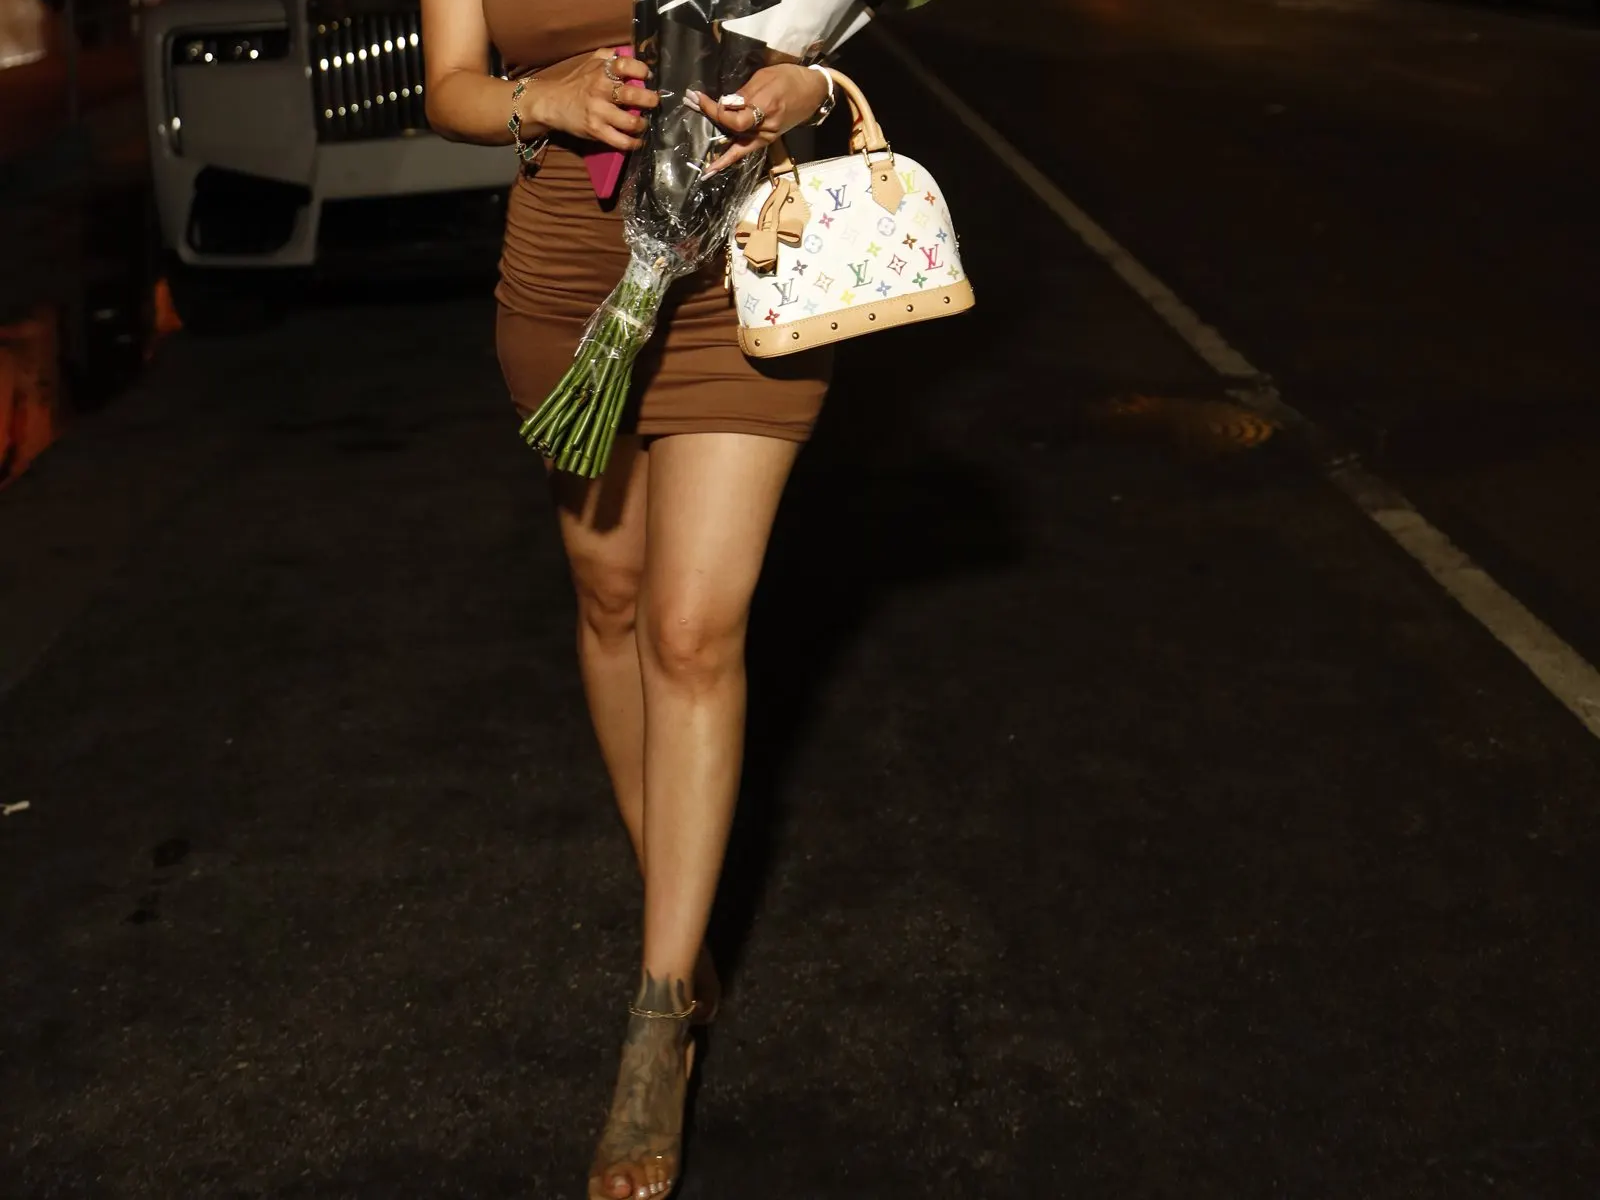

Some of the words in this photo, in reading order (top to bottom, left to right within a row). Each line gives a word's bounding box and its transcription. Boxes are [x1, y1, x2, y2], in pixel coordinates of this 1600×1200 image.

[826, 184, 852, 212] LV
[919, 243, 944, 271] LV
[847, 259, 873, 289] LV
[772, 277, 799, 308] LV
